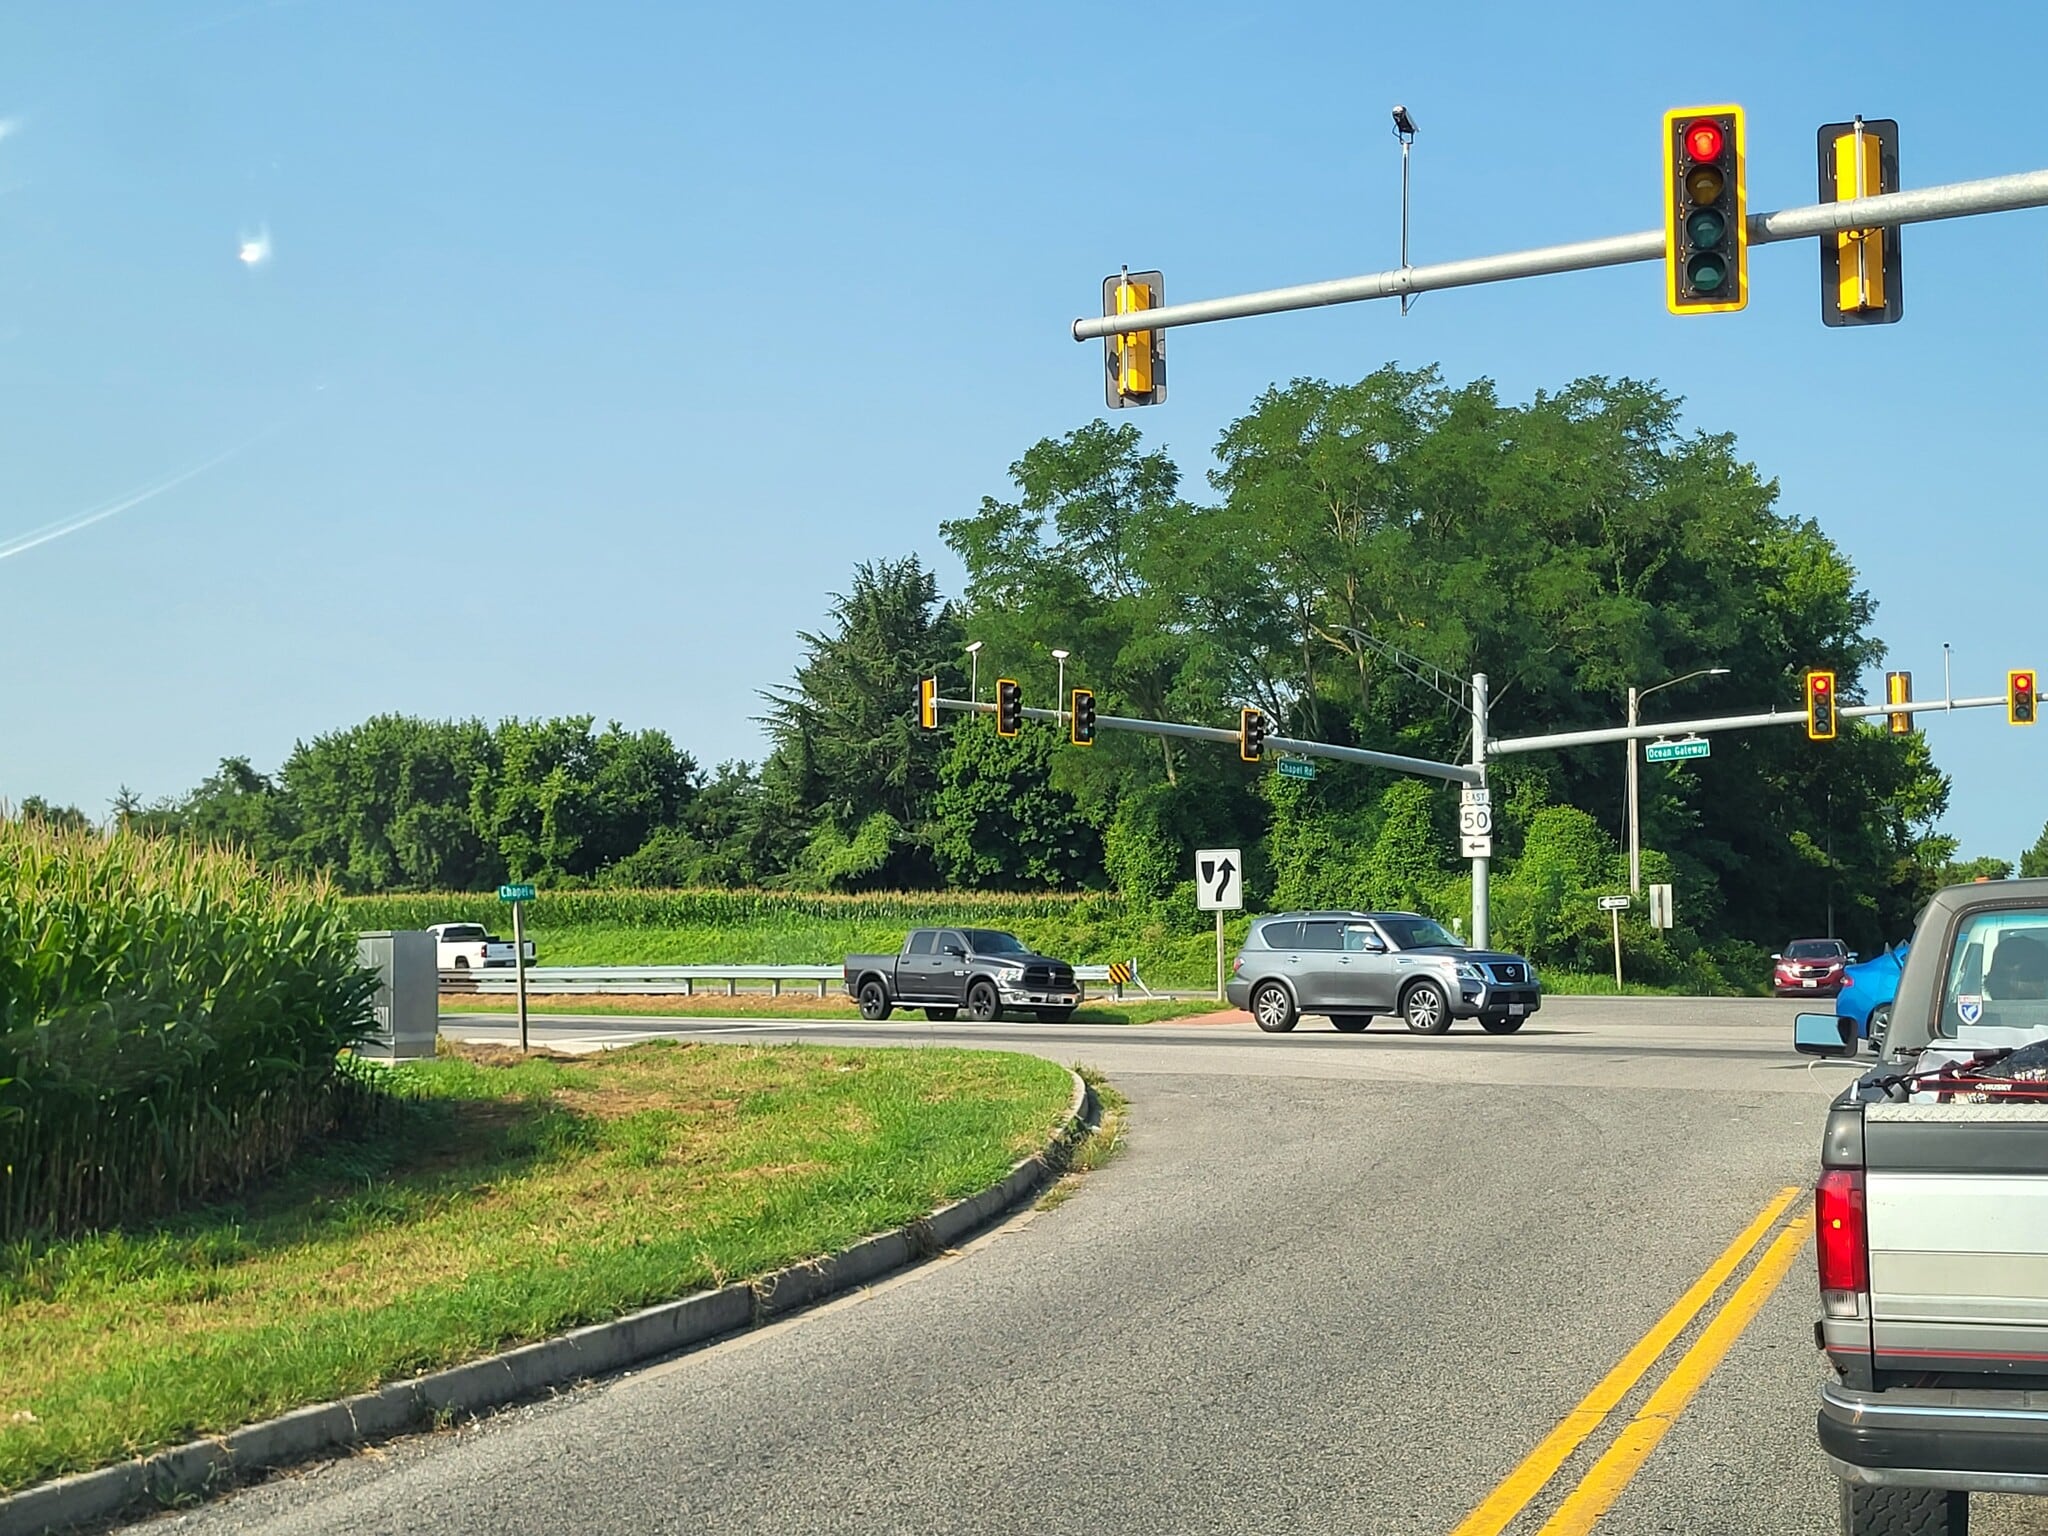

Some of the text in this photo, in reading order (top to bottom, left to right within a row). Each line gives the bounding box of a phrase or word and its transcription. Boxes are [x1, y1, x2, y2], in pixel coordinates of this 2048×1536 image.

[1648, 745, 1707, 758] Ocean Gateway
[1465, 792, 1485, 802] EAST
[1463, 811, 1488, 829] 50
[500, 886, 529, 899] Chapel
